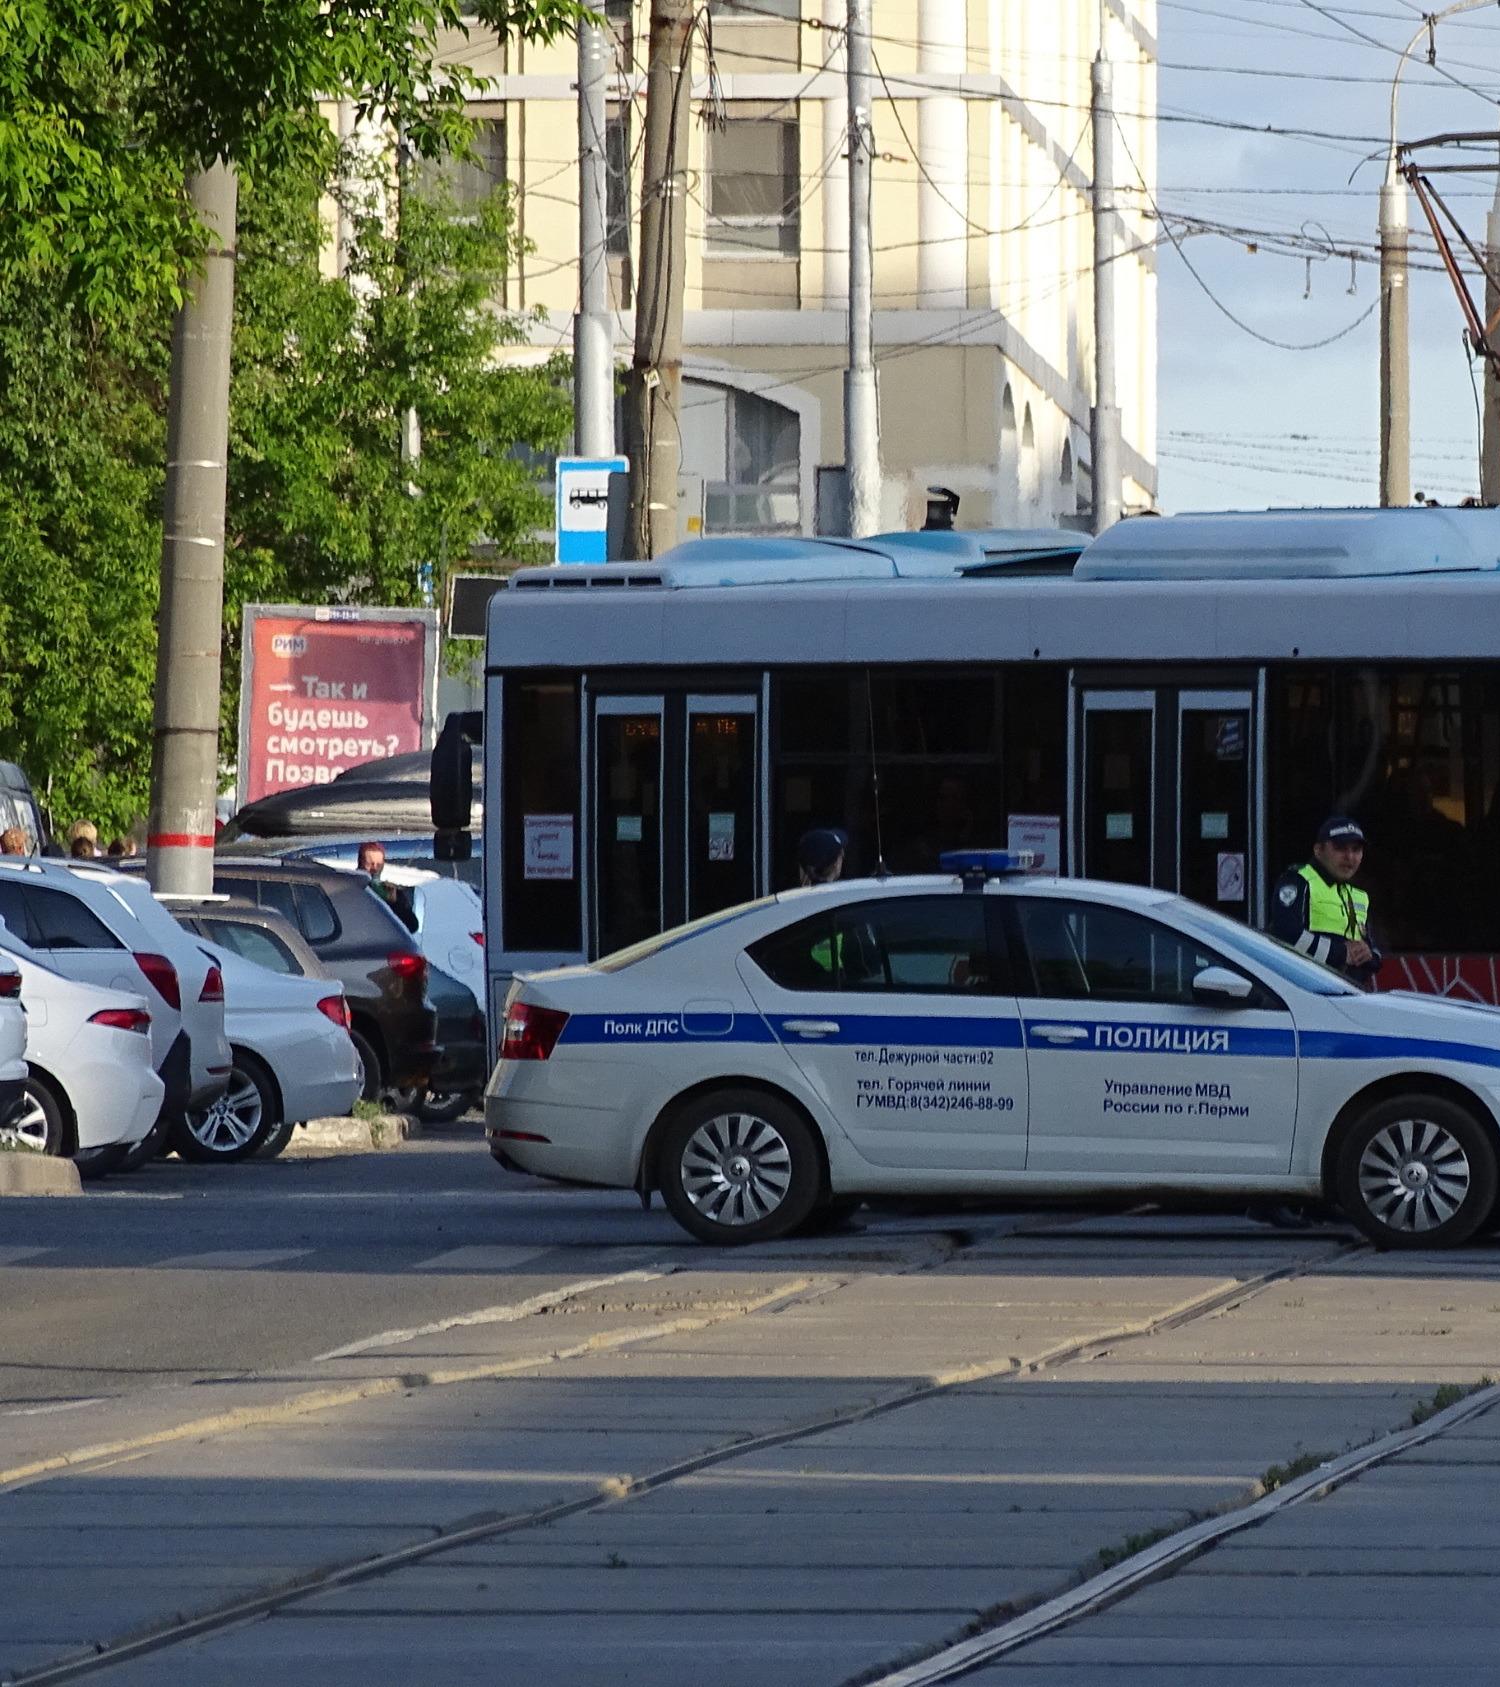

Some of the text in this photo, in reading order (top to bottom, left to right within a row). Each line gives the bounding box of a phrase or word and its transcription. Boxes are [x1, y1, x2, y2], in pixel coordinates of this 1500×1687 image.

[302, 675, 347, 699] Так
[352, 682, 368, 699] и
[267, 701, 369, 732] будешь
[266, 734, 400, 760] смотреть?
[604, 1020, 679, 1037] Полк ДПС
[1095, 1025, 1230, 1053] ПОЛИЦИЯ
[857, 1077, 991, 1093] тел. Горячей линии
[1104, 1079, 1232, 1099] Управление МВД
[1103, 1098, 1160, 1114] России
[1164, 1102, 1183, 1115] по
